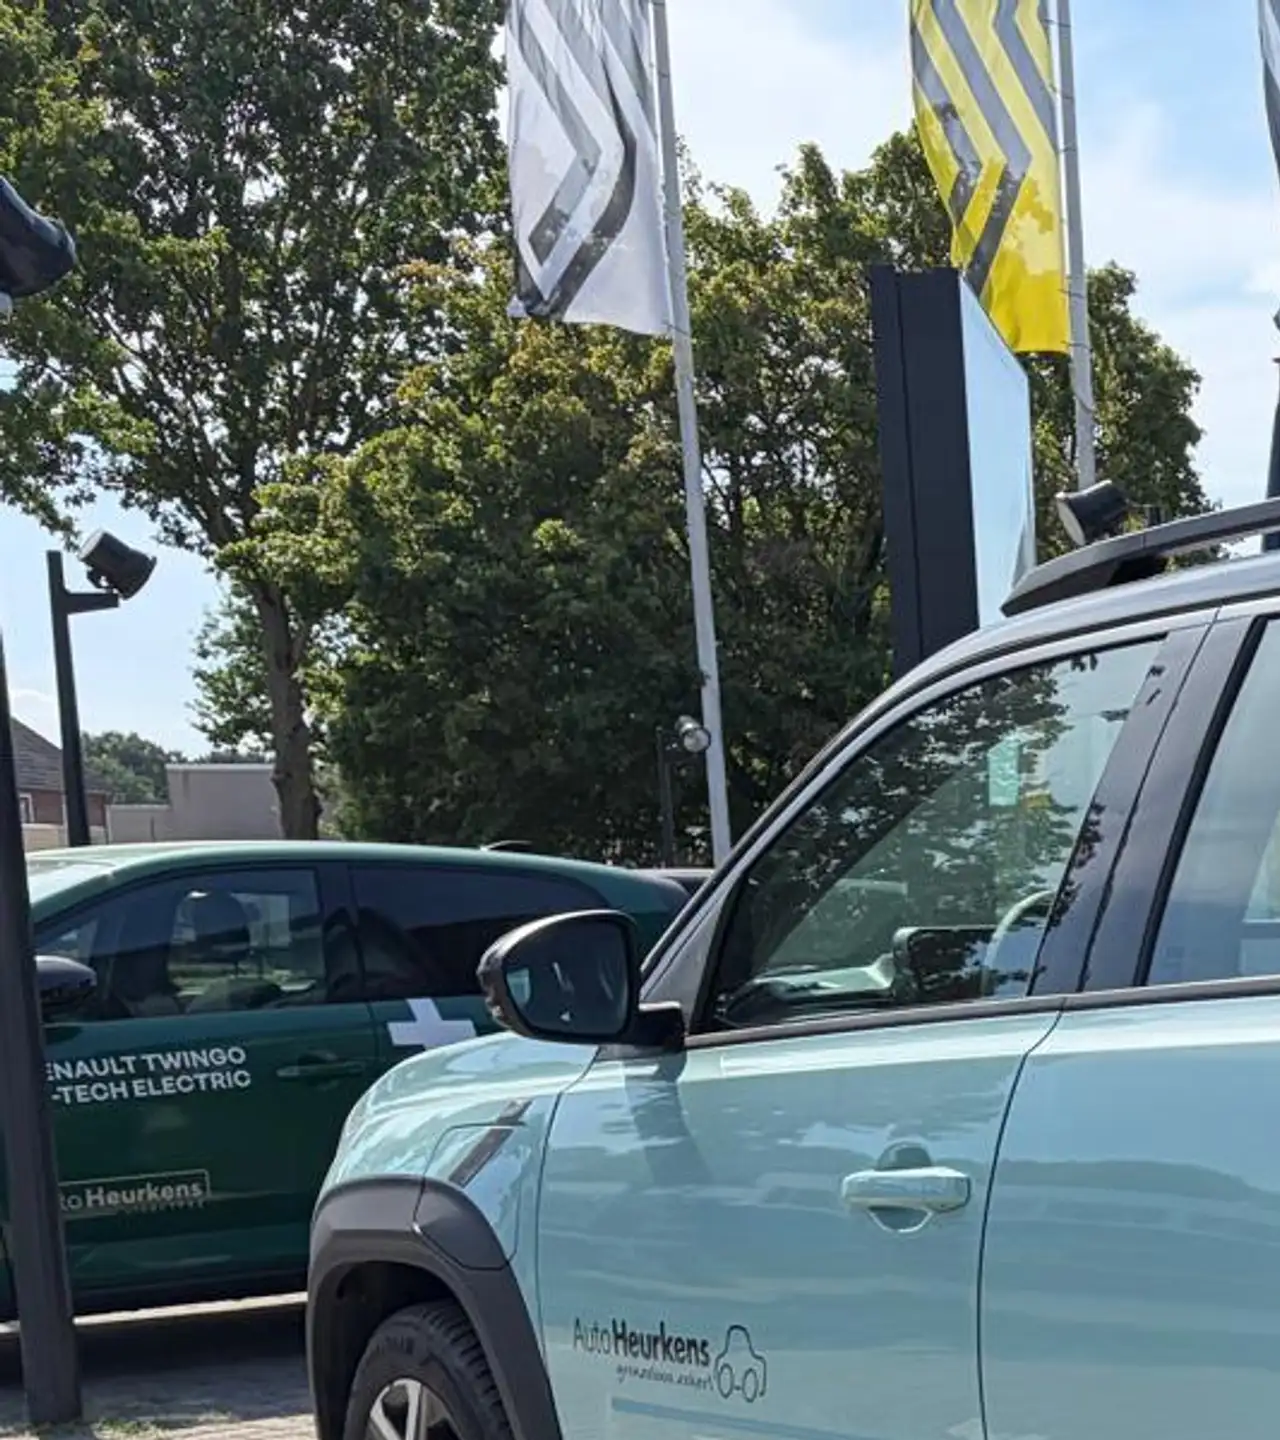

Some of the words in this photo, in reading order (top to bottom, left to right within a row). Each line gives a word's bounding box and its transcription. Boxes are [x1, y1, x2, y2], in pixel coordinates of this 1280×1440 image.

[46, 1055, 136, 1081] ENAULT
[141, 1046, 247, 1071] TWINGO
[51, 1080, 128, 1104] -TECH
[133, 1070, 251, 1097] ELECTRIC
[60, 1182, 203, 1211] toHeurkens
